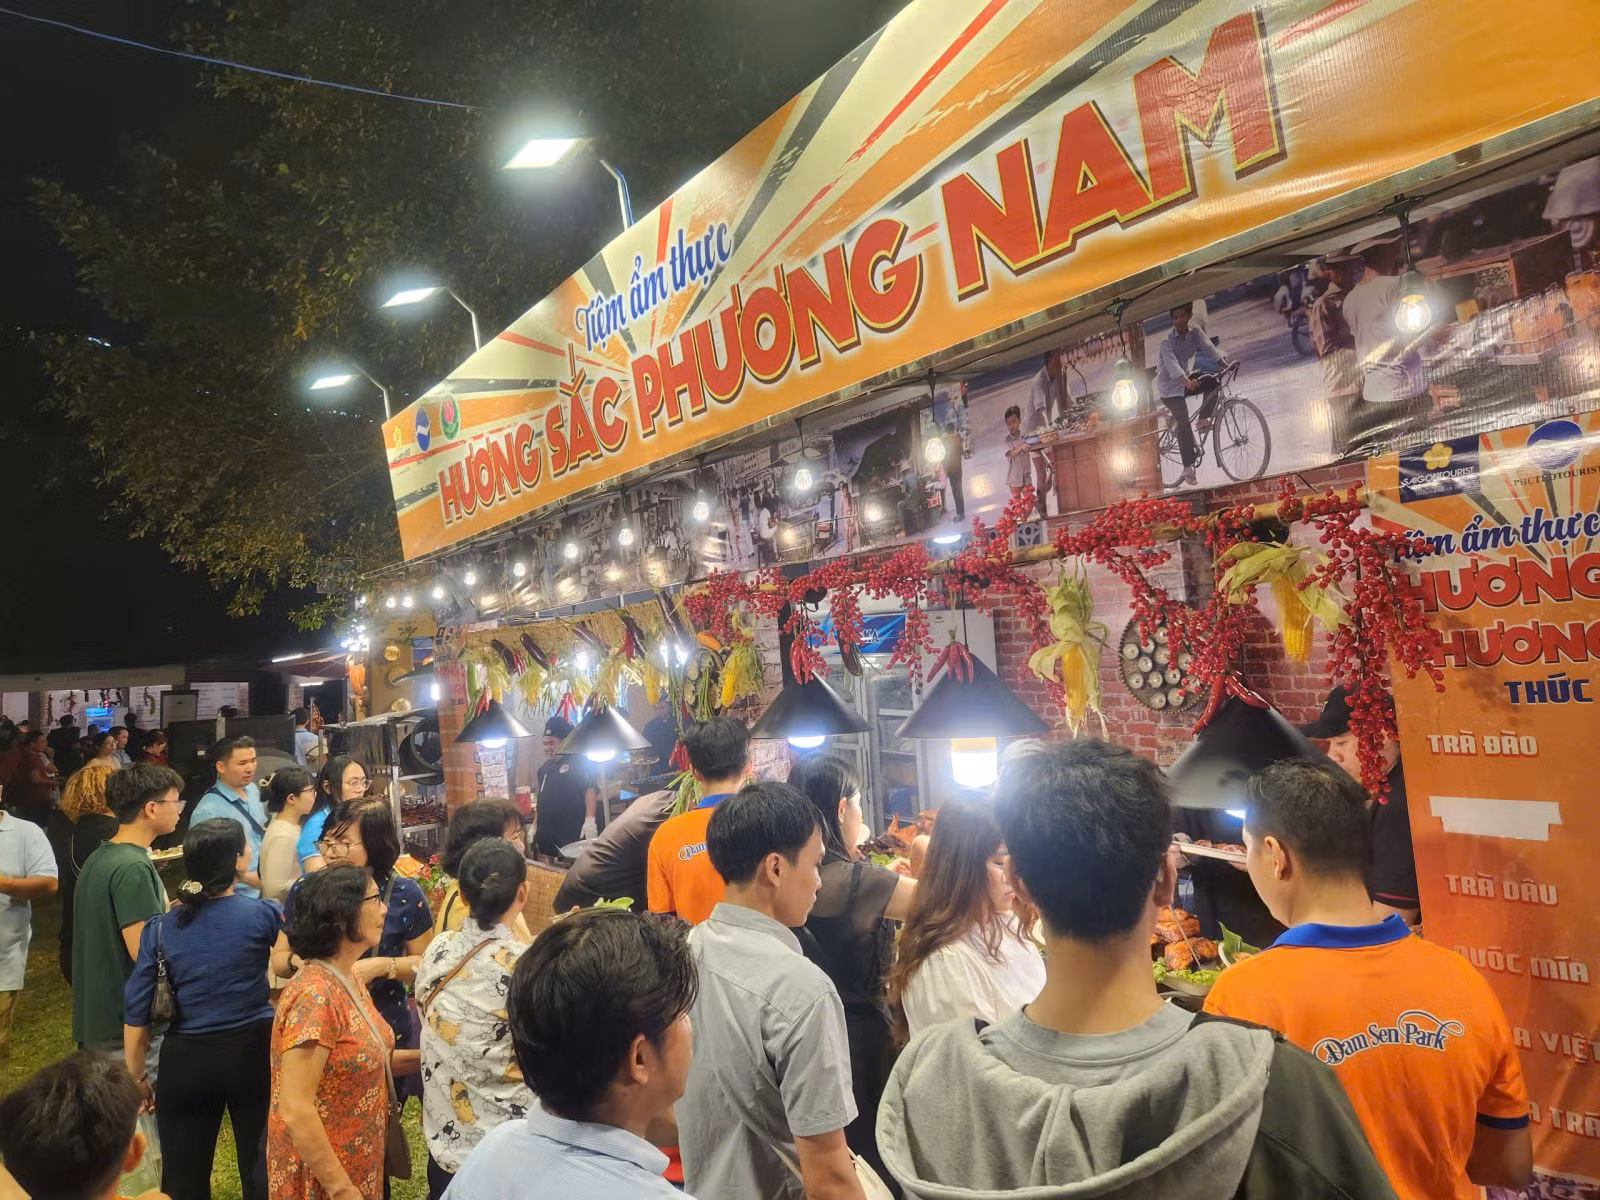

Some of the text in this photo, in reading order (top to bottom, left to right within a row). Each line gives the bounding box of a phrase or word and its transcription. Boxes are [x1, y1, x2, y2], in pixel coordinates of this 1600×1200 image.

[438, 6, 1287, 525] HƯƠNG SẮC PHƯƠNG NAM
[575, 222, 732, 351] Tiệm ẩm thực
[1401, 466, 1475, 488] SAIGONTOURIST
[1394, 528, 1456, 564] iệm
[1461, 515, 1518, 552] ẩm
[1431, 620, 1600, 667] HƯƠN
[1503, 671, 1595, 705] THỨC
[1426, 729, 1538, 756] TRÀ ĐÀO
[1444, 872, 1495, 898] TRÀ
[1312, 1033, 1369, 1065] Dam
[1367, 1022, 1400, 1045] Sen
